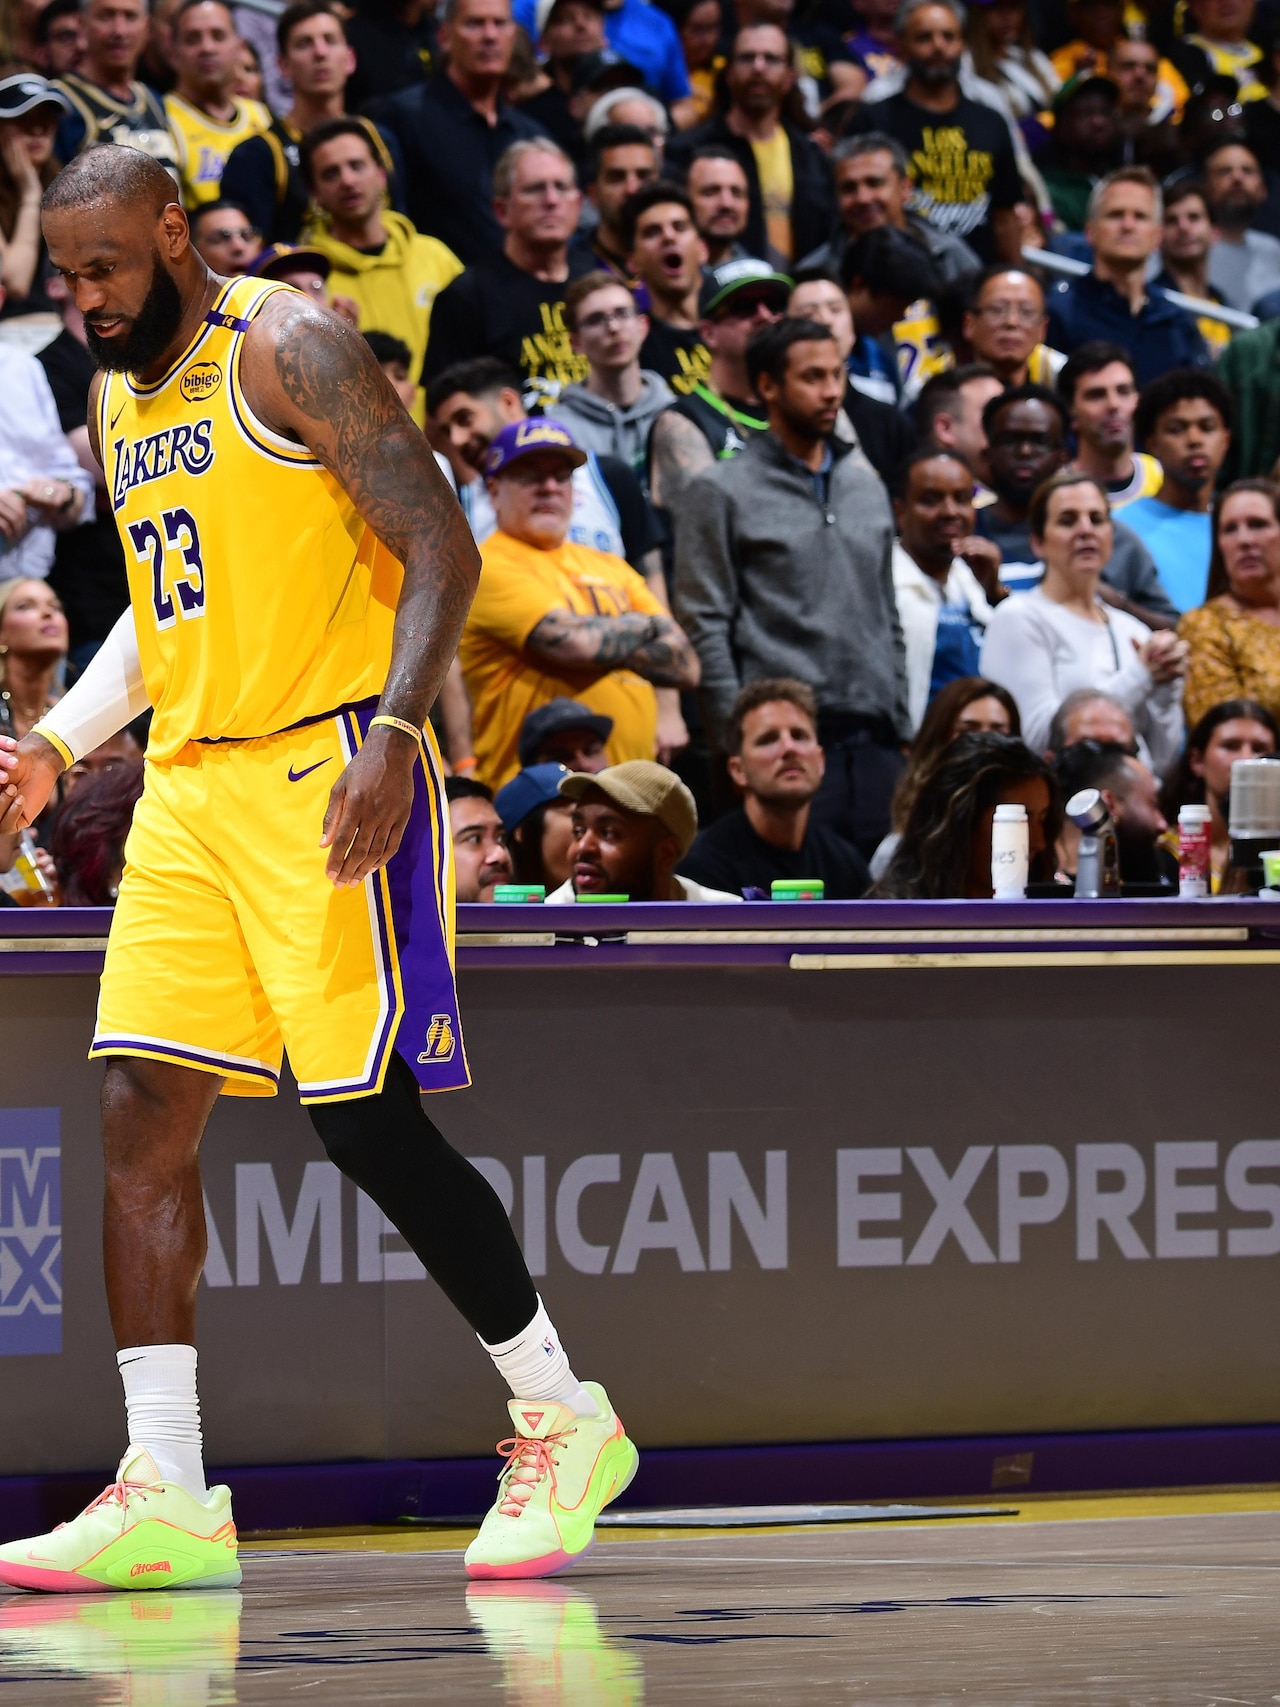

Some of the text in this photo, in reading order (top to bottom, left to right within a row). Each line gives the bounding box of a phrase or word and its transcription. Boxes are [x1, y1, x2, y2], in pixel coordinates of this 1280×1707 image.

[184, 372, 220, 388] bibigo
[112, 418, 216, 513] LAKERS
[125, 505, 206, 632] 23
